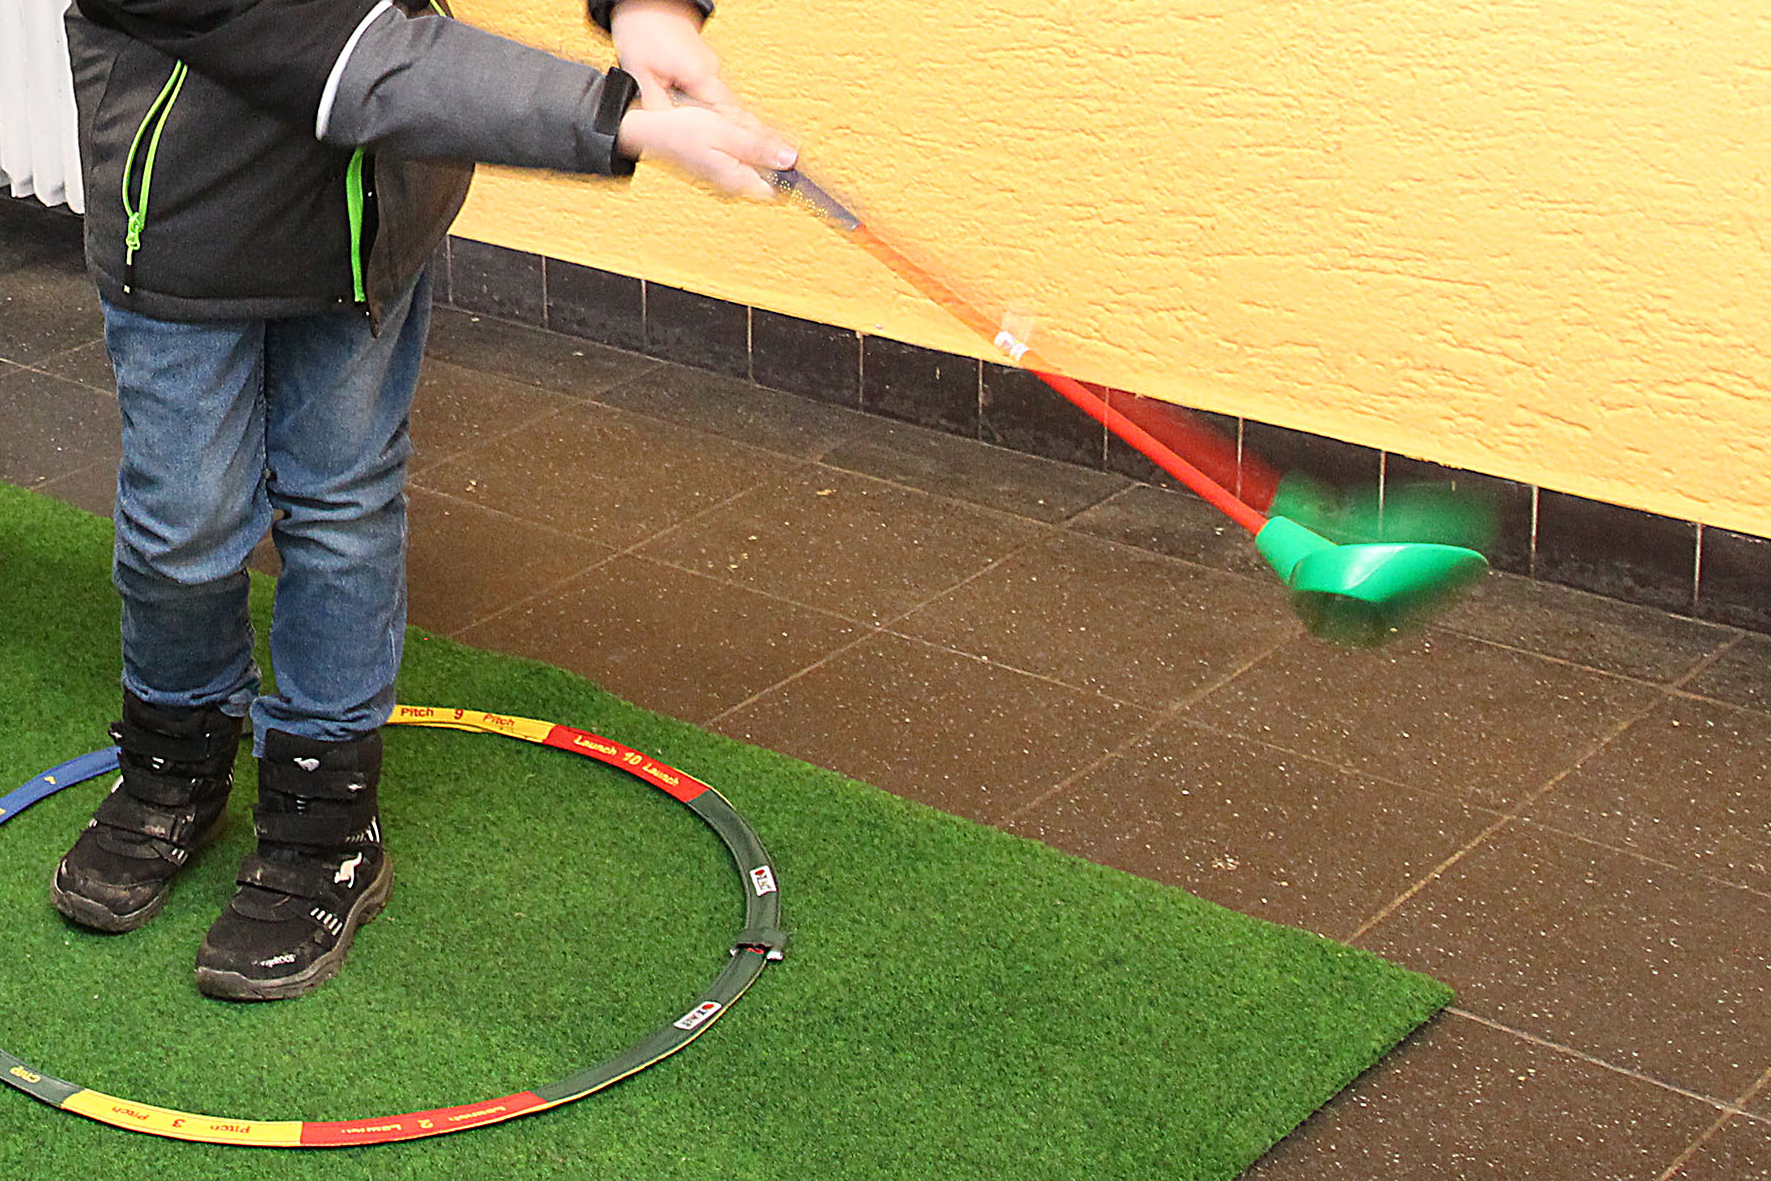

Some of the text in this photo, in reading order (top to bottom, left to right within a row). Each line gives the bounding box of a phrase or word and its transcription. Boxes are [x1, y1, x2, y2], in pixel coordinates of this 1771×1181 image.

[400, 707, 516, 727] Pitch 9 Pitch
[573, 735, 680, 787] Launch 10 Launch
[111, 1105, 150, 1121] Pitch
[171, 1118, 186, 1128] 3
[417, 1119, 434, 1129] 2
